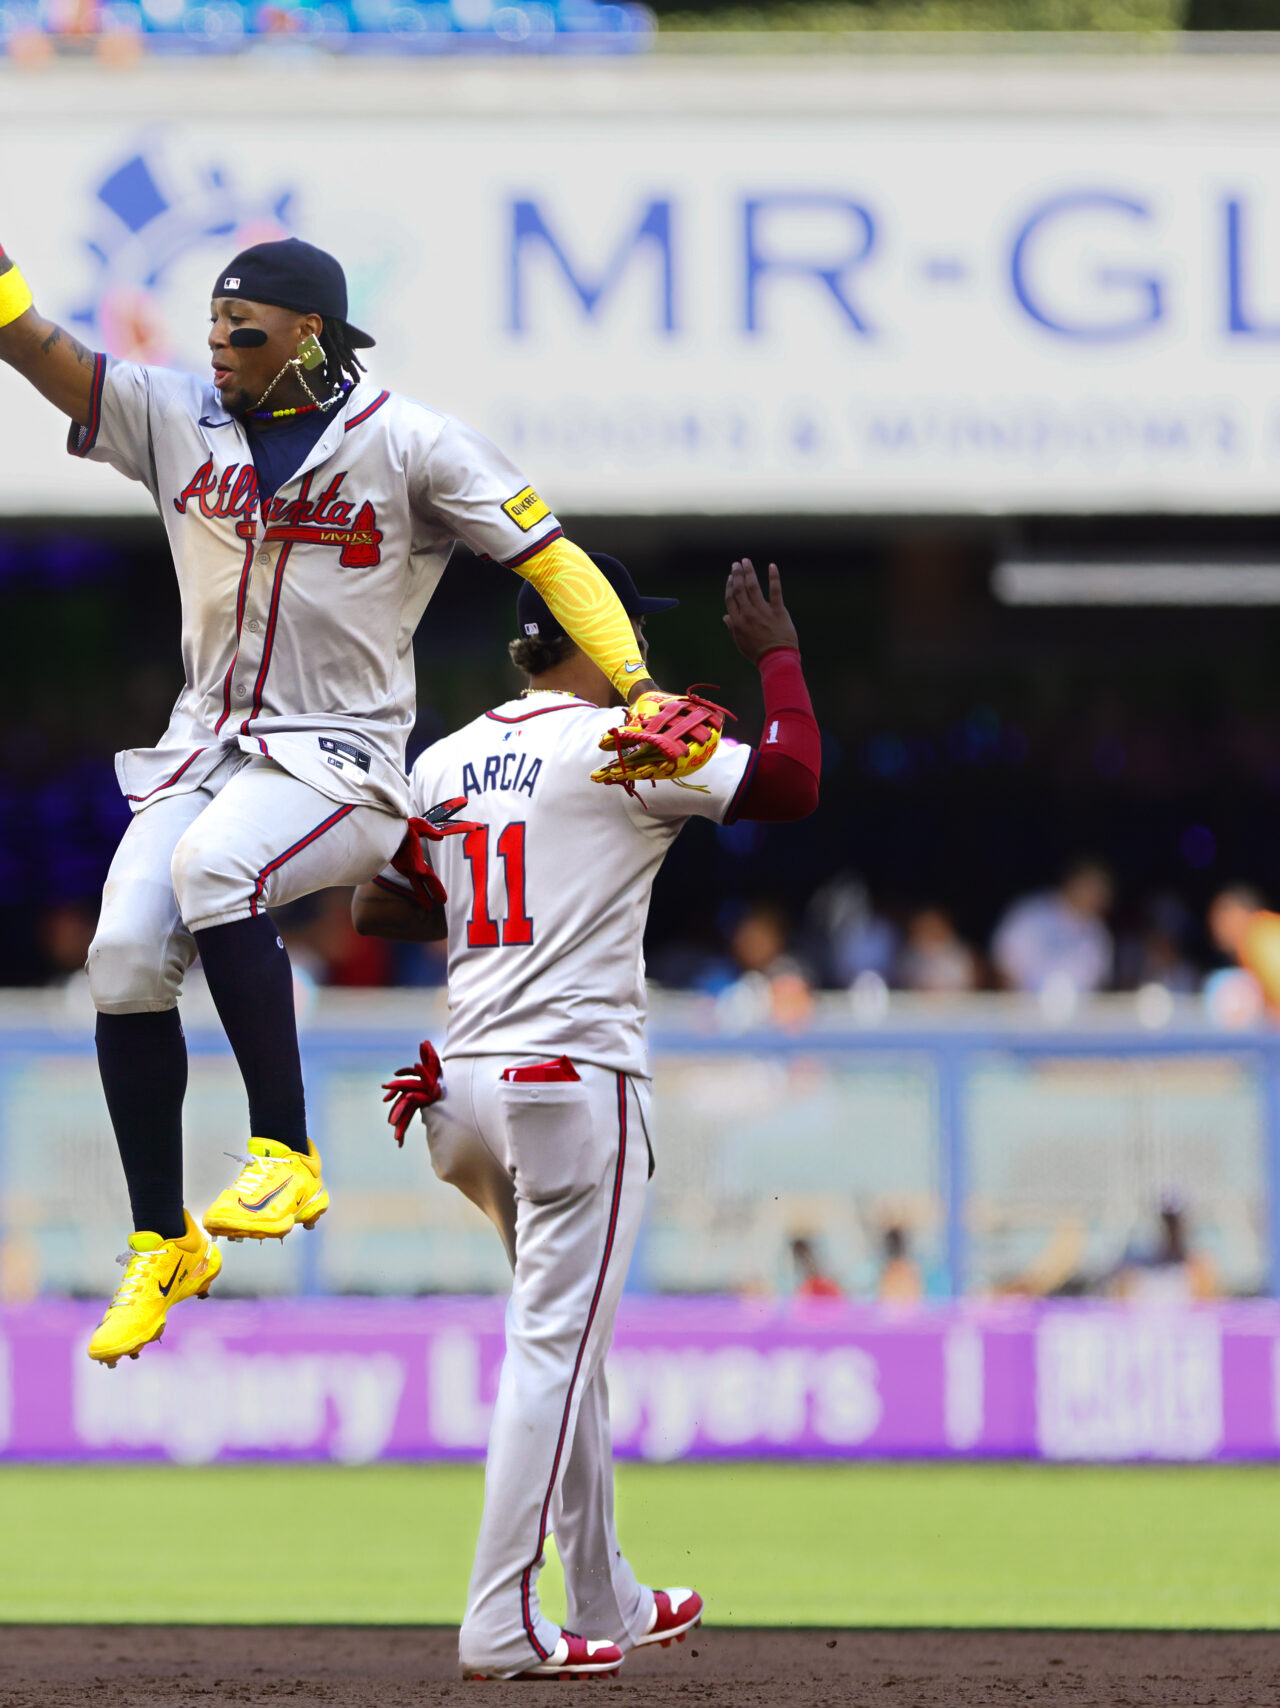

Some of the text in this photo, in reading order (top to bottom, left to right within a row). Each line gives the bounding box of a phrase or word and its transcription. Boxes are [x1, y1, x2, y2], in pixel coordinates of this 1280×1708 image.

[506, 192, 1280, 342] MR-GL
[461, 752, 543, 798] ARCIA
[462, 821, 534, 949] 11
[428, 1326, 884, 1464] Lyers
